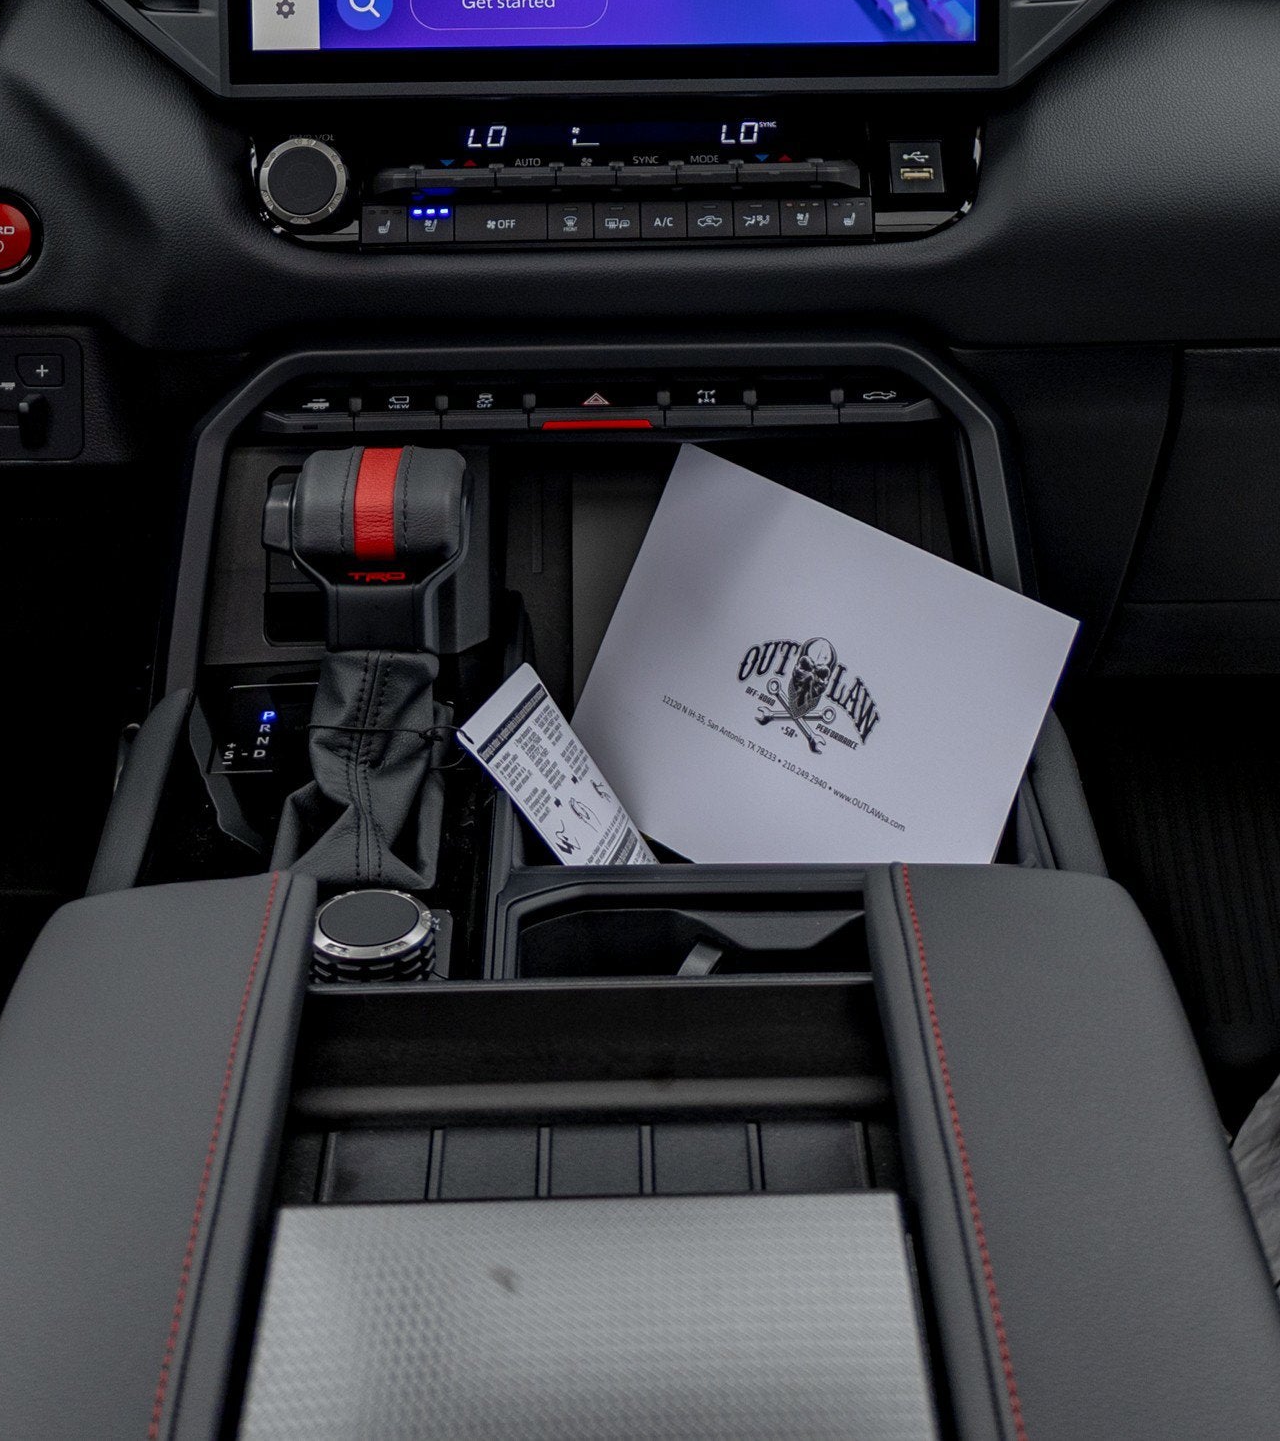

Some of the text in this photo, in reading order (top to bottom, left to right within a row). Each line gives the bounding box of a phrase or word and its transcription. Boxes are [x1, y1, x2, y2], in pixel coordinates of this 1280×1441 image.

[467, 125, 508, 148] LO
[514, 157, 541, 167] AUTO
[632, 155, 659, 165] SYNC
[690, 154, 720, 164] MODE
[497, 219, 516, 230] OFF
[653, 216, 674, 228] A/C
[347, 571, 406, 583] TRD
[263, 711, 275, 720] P
[259, 724, 271, 732] R
[256, 736, 270, 745] N
[815, 723, 859, 751] PERFORMANCE
[253, 749, 266, 758] D
[661, 694, 906, 832] 12120 N IH-35, San Antonio, TX 78233 210.249.2940 www.OUTLAWsa.com
